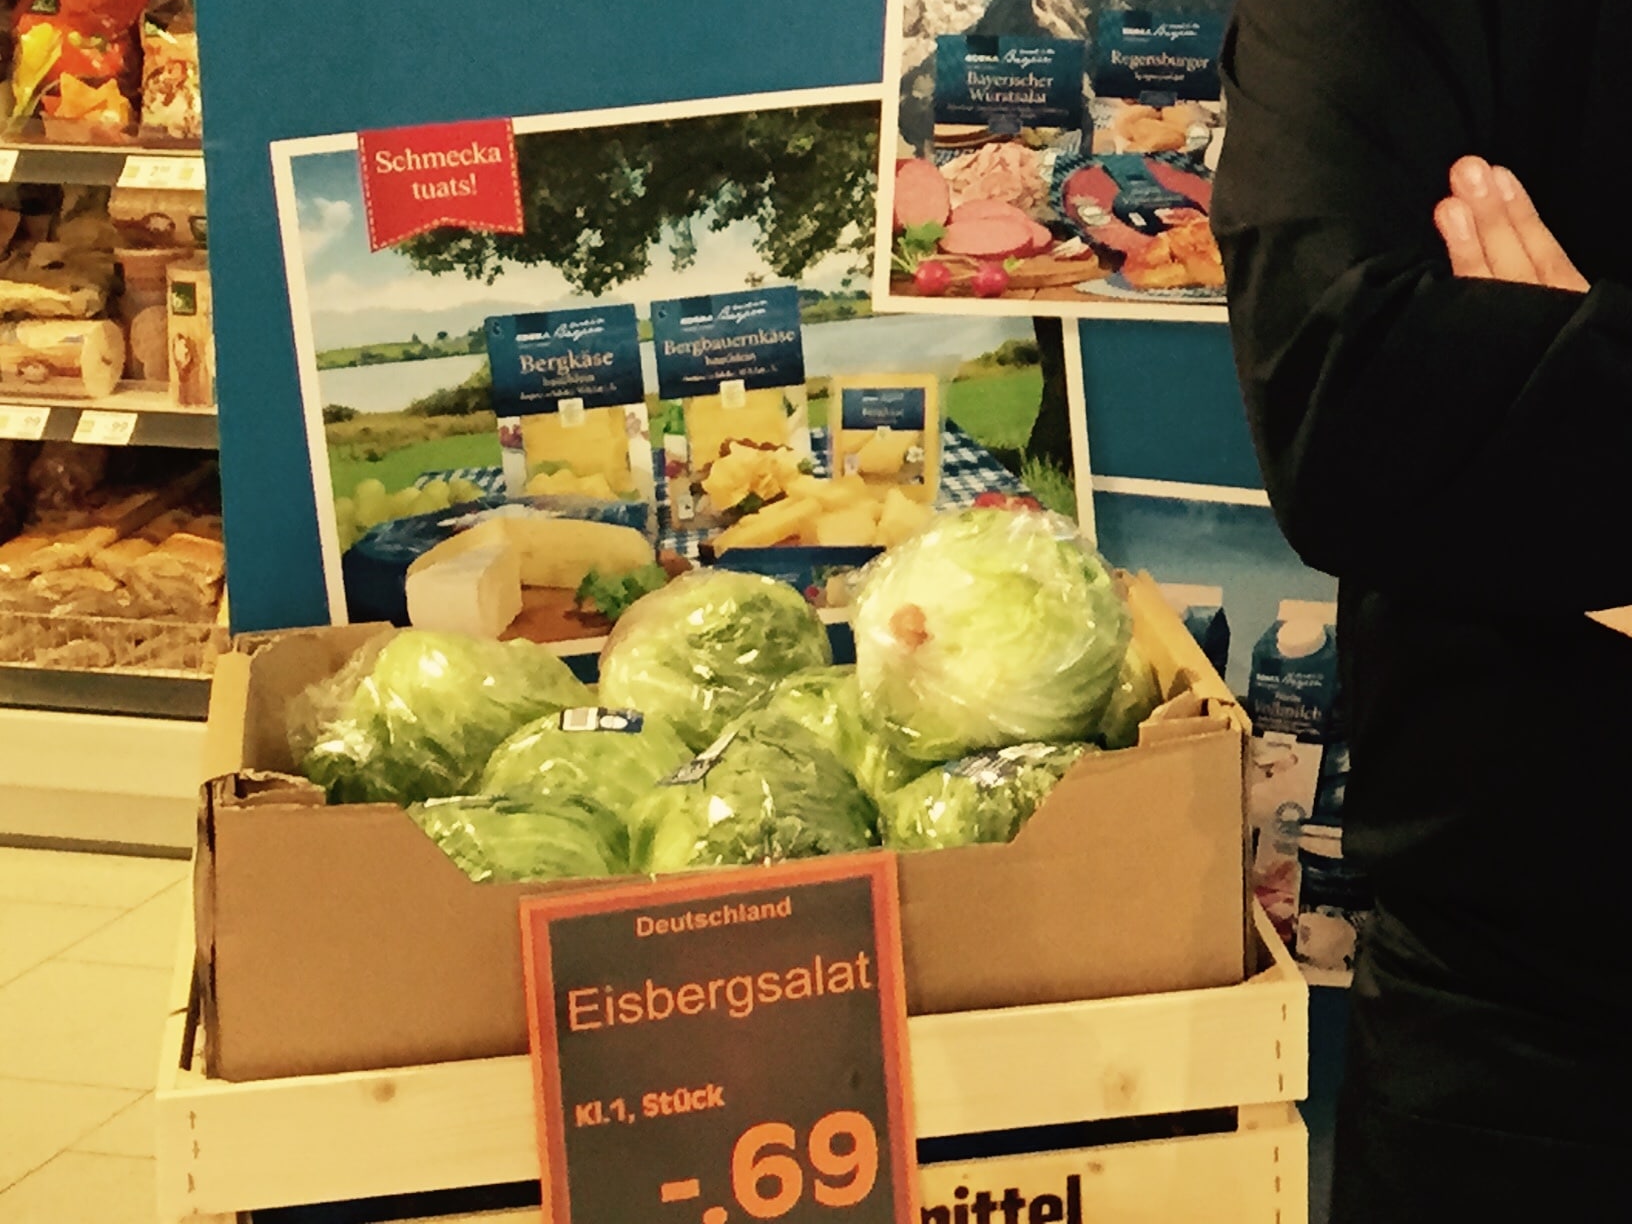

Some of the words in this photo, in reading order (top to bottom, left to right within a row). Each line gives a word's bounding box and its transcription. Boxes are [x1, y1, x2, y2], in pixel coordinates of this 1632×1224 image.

[375, 141, 503, 174] Schmecka
[411, 172, 478, 200] tuats!
[663, 328, 797, 357] Bergbauernkäse
[518, 348, 615, 375] Bergkäse
[635, 896, 793, 937] Deutschland
[568, 950, 873, 1032] Eisbergsalat
[642, 1083, 726, 1118] Stück
